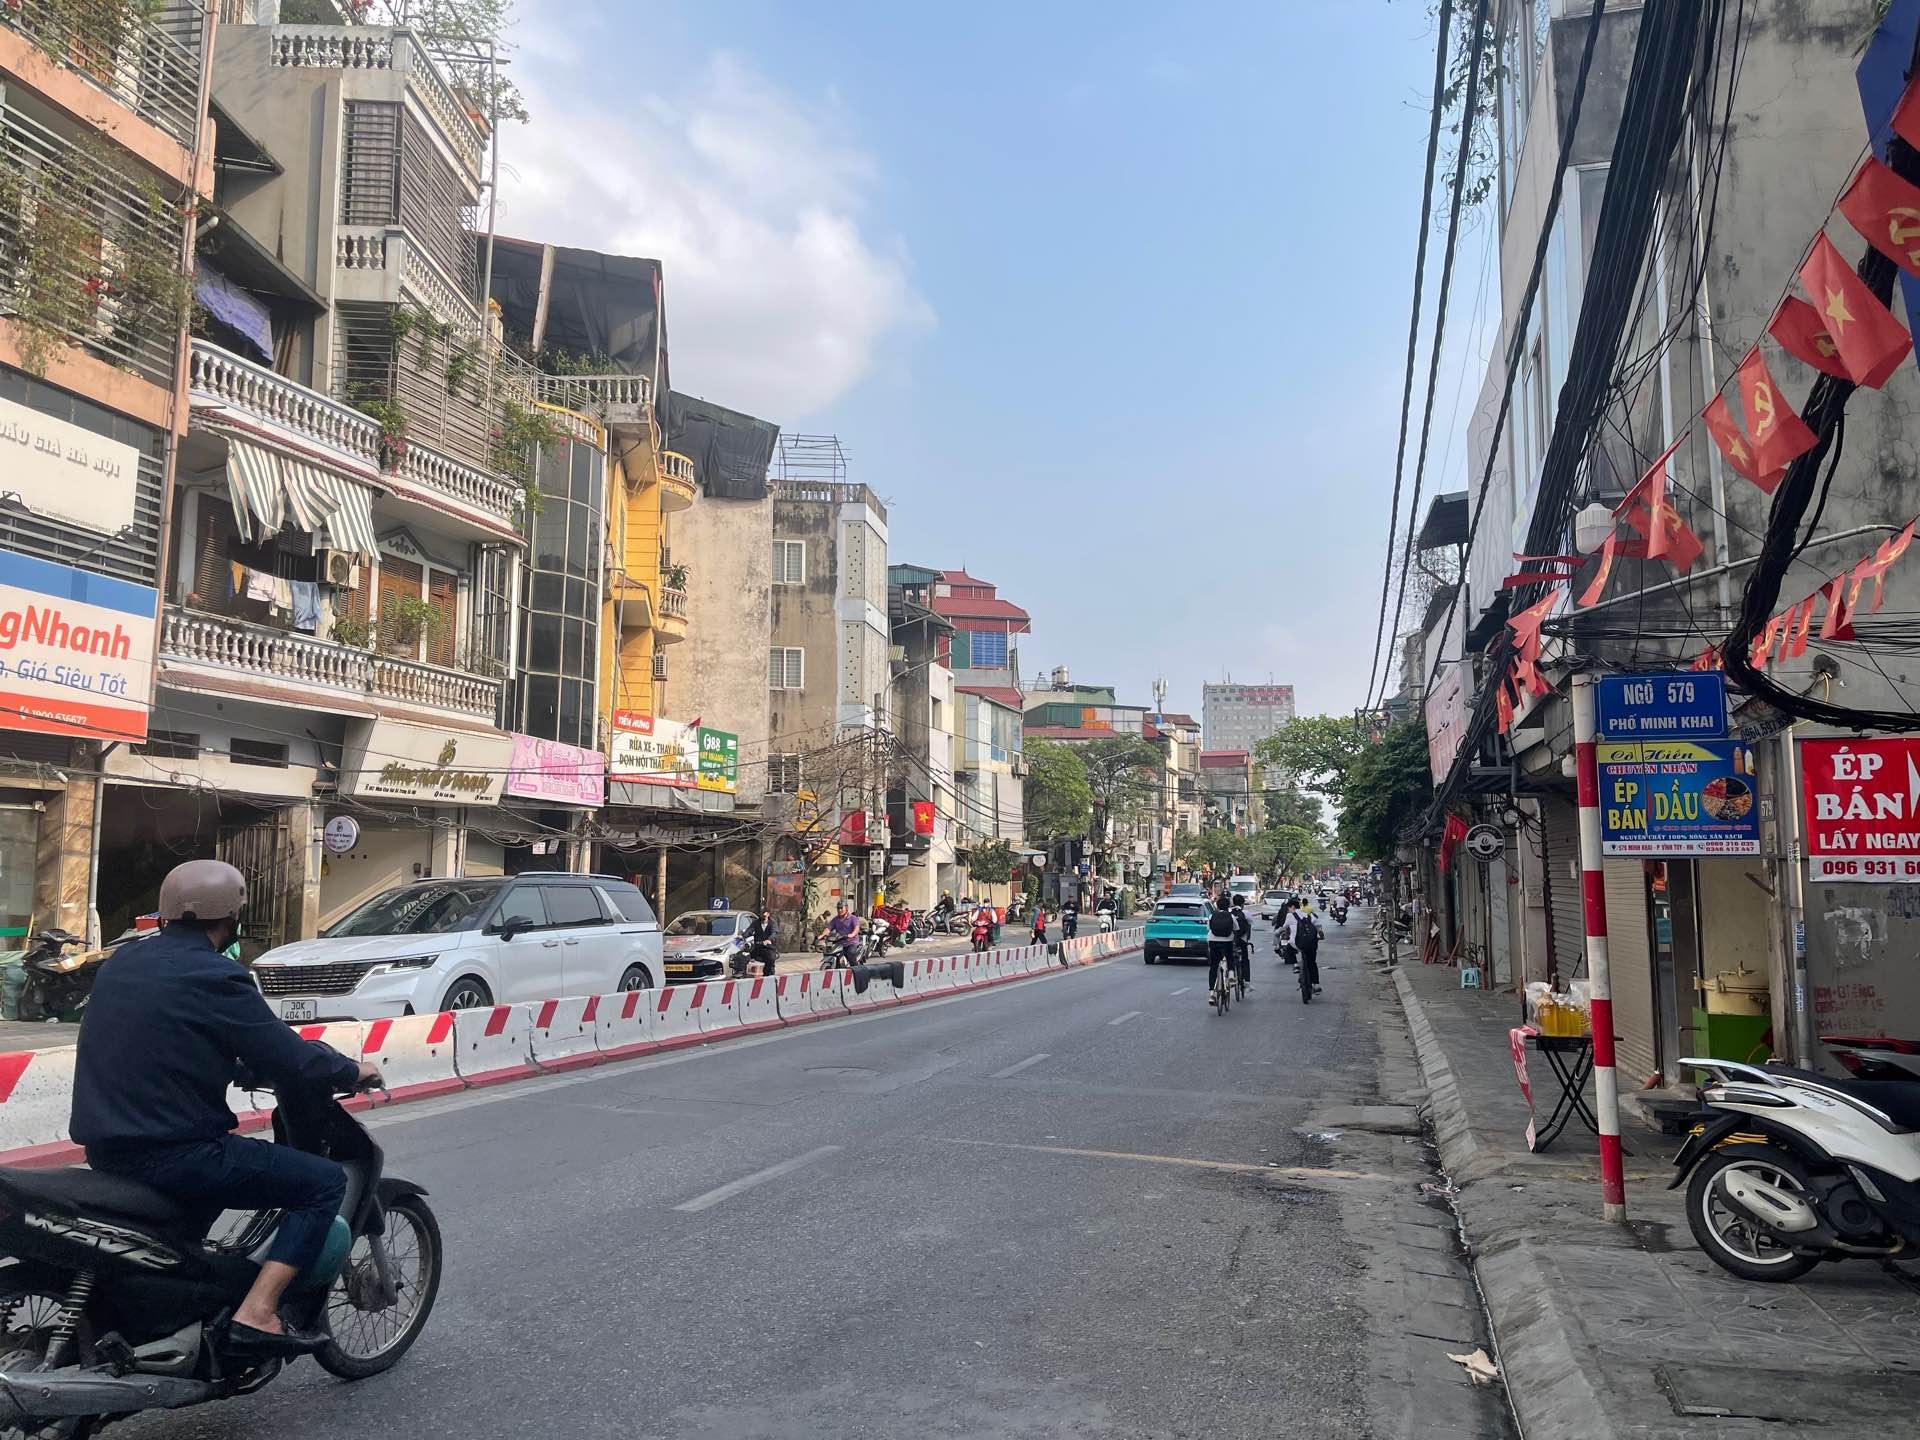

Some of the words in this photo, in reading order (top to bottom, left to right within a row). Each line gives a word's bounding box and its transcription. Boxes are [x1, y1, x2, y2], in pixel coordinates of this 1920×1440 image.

[0, 604, 131, 661] gNhanh
[17, 658, 48, 680] Giá
[55, 665, 92, 690] Siêu
[99, 671, 128, 695] Tốt
[1623, 679, 1653, 705] NGÕ
[1667, 682, 1695, 704] 579
[1609, 713, 1637, 730] PHỐ
[1640, 717, 1677, 729] MINH
[1681, 715, 1714, 728] KHAI
[1830, 746, 1883, 780] ÉP
[1614, 778, 1639, 803] ÉP
[1654, 778, 1699, 821] DẦU
[1814, 786, 1904, 820] BÁN
[1608, 804, 1647, 830] BÁN
[1761, 800, 1773, 817] 579
[1820, 827, 1861, 849] LẤY
[1866, 832, 1920, 849] NGAY
[1823, 861, 1858, 876] 096
[1864, 861, 1896, 876] 931
